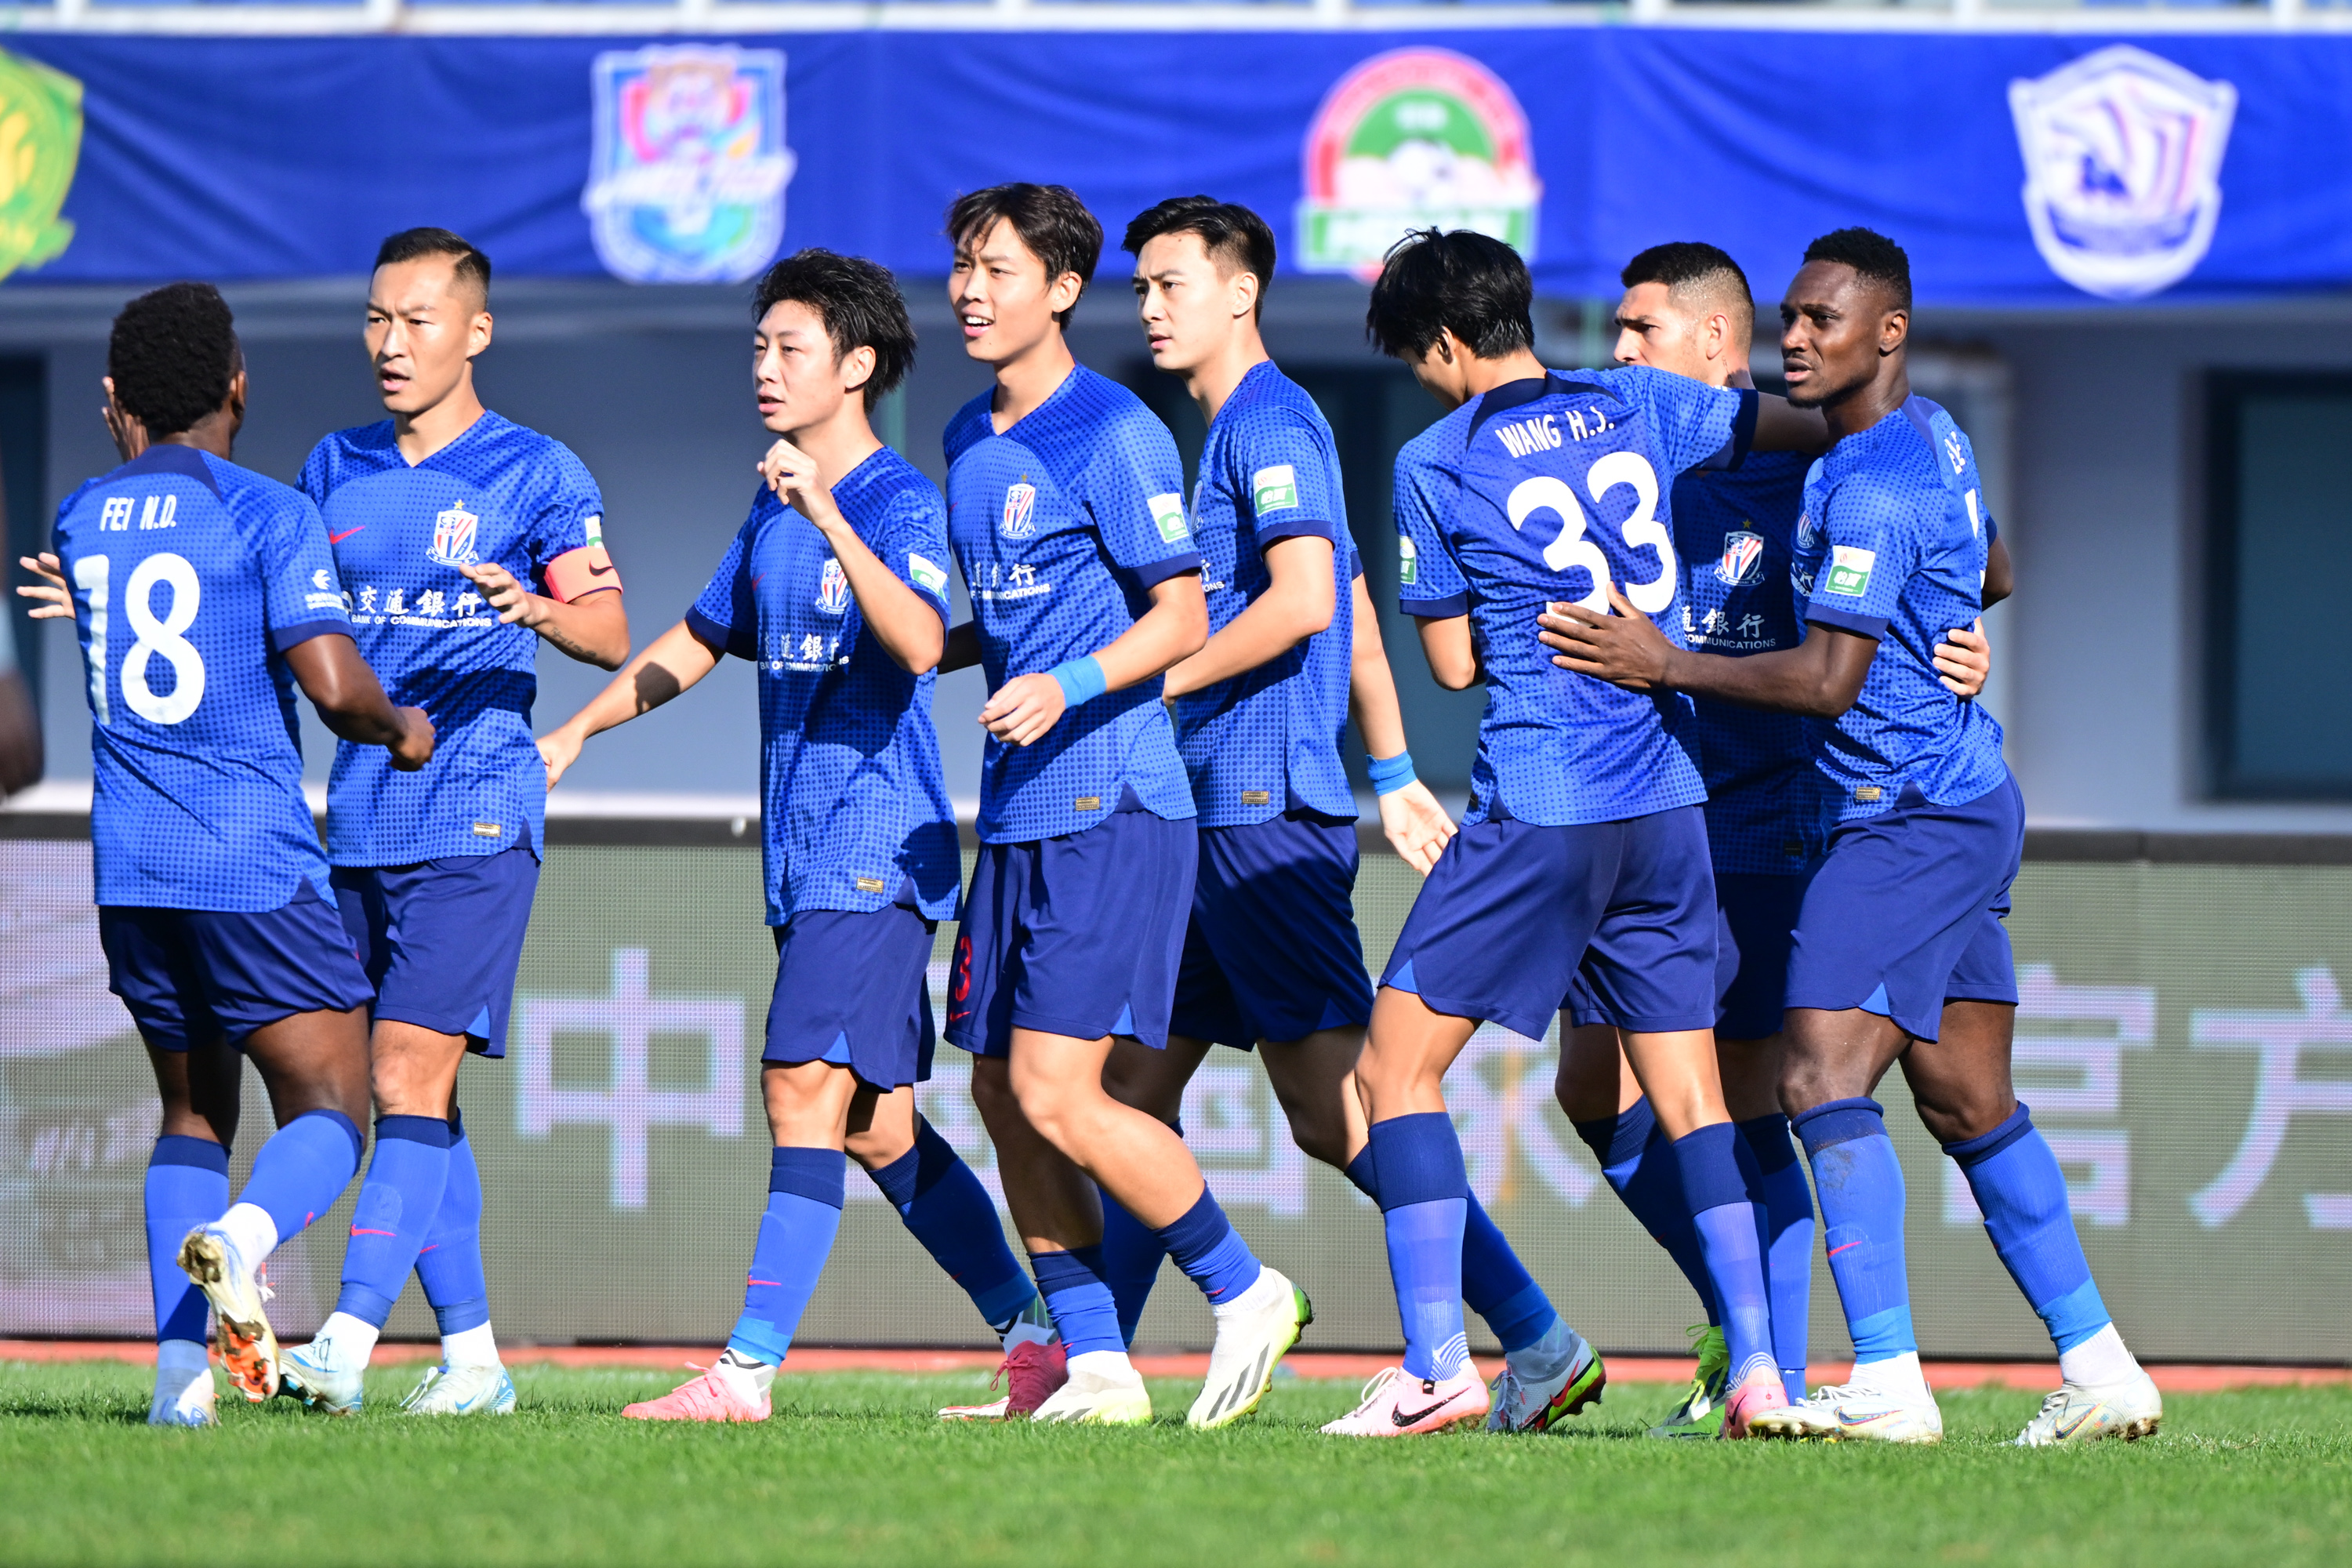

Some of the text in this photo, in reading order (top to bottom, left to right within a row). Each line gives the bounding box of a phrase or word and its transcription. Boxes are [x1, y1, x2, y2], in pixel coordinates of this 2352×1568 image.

[1494, 406, 1615, 458] WANG H.J.
[100, 494, 177, 532] FEI N.D.
[1507, 451, 1677, 628] 33
[351, 615, 492, 629] BANK OF COMMUNICATIONS
[358, 586, 482, 618] 交通銀行
[74, 552, 205, 725] 18
[956, 936, 972, 1001] 3
